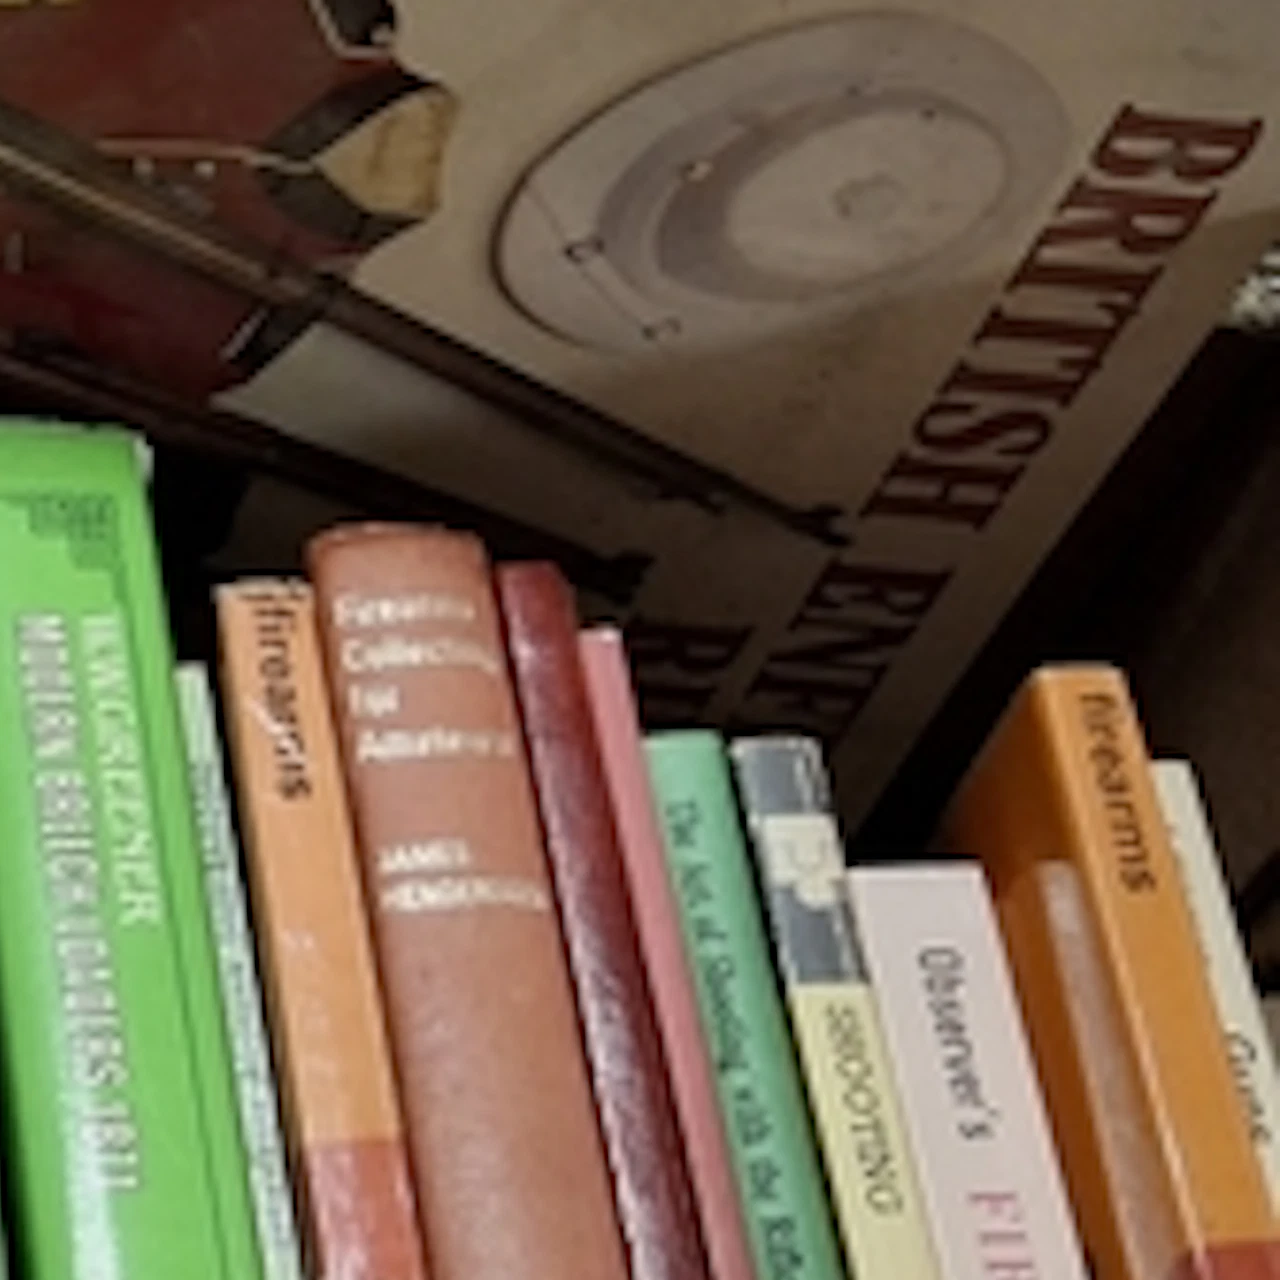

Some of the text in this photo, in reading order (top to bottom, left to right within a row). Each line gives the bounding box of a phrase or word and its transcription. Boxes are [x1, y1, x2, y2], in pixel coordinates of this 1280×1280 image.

[857, 102, 1266, 533] BRITISH
[1078, 692, 1159, 896] firearms
[823, 1001, 905, 1217] SHOOTING
[917, 945, 1001, 1142] Observer's
